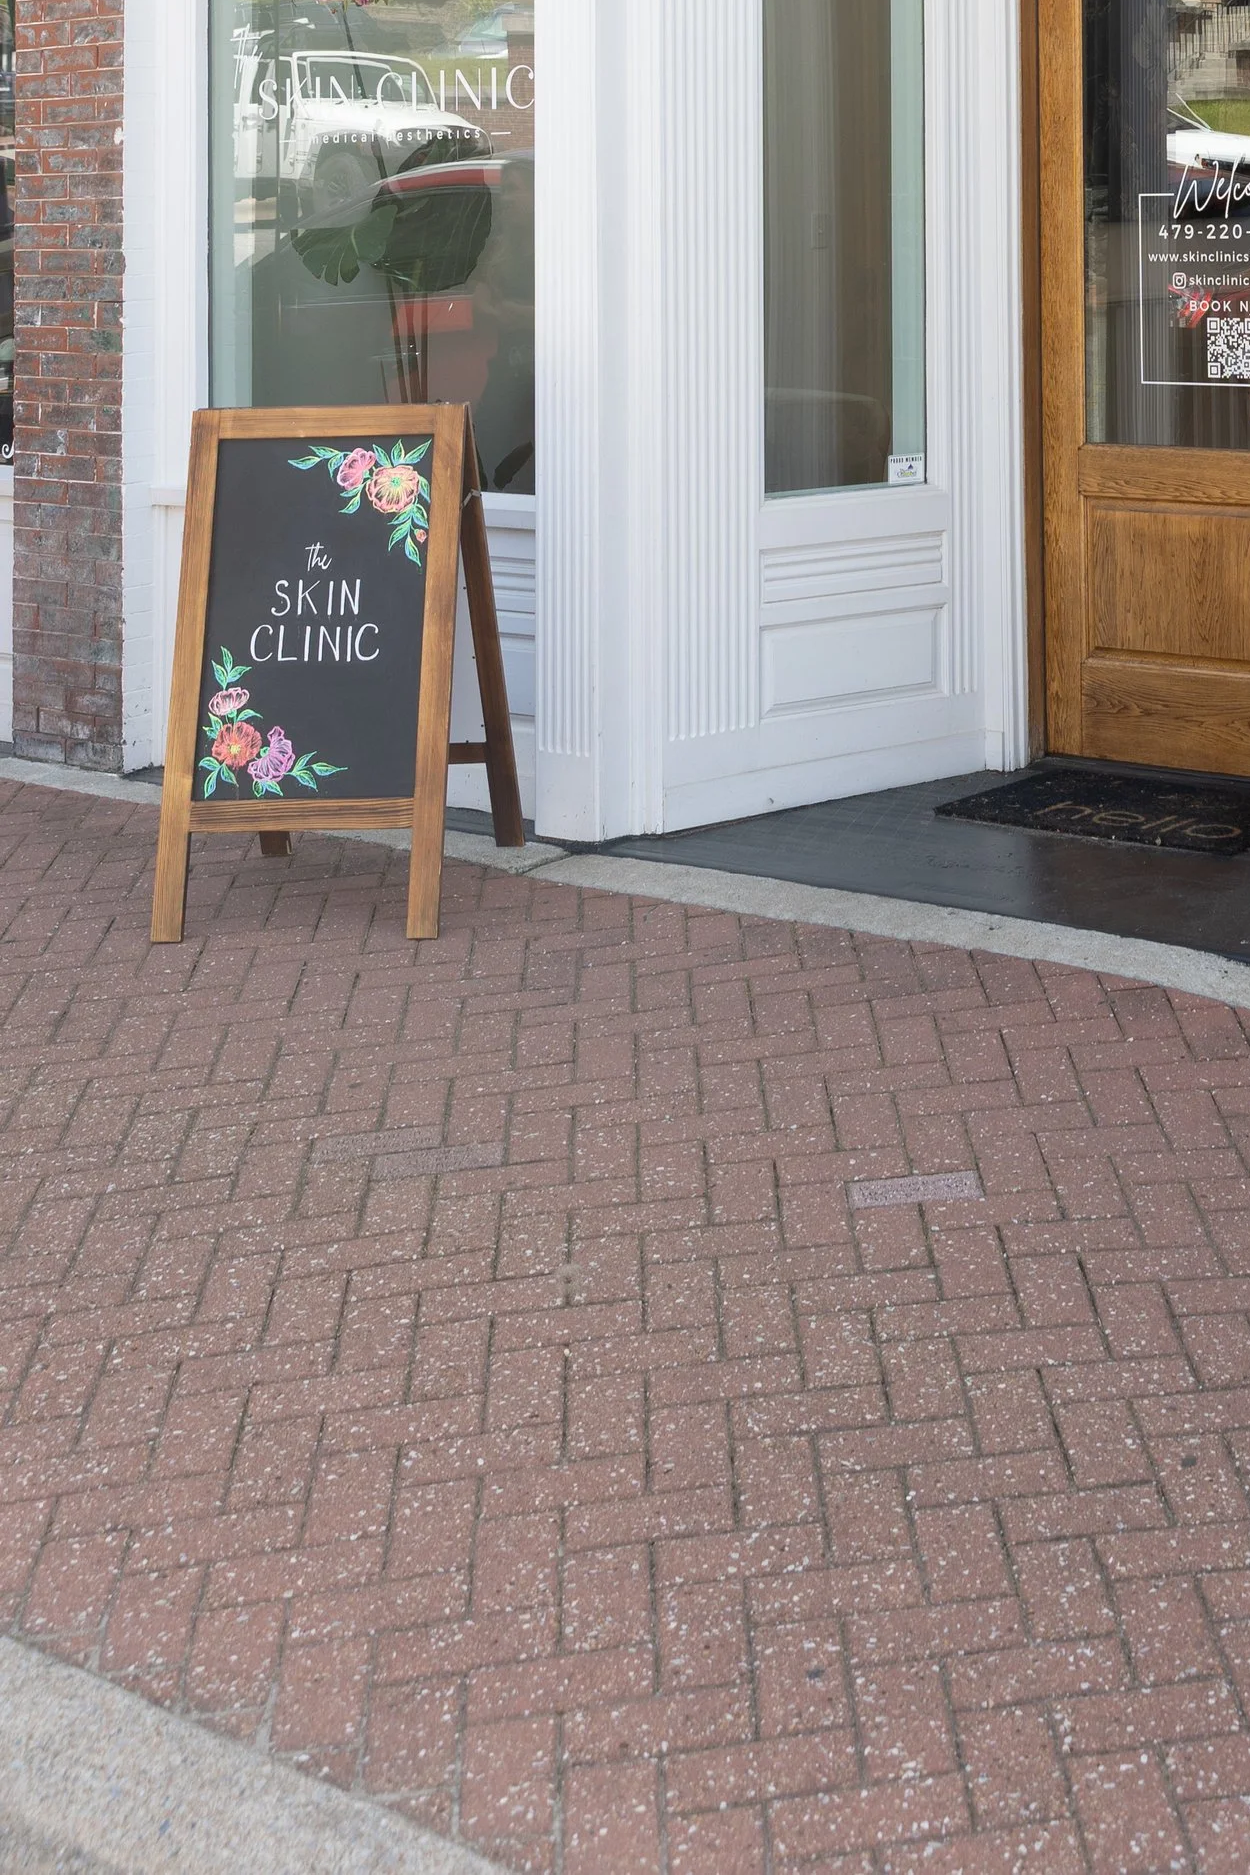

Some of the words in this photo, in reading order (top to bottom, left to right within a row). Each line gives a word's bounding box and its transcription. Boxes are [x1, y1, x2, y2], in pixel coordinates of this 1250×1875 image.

[258, 73, 355, 121] SKIN
[376, 64, 535, 112] CLINIC
[309, 131, 375, 145] medical
[385, 127, 482, 143] aesthetics
[1188, 300, 1232, 313] BOOK
[304, 541, 333, 572] the
[270, 578, 362, 617] SKIN
[249, 623, 380, 663] CLINIC
